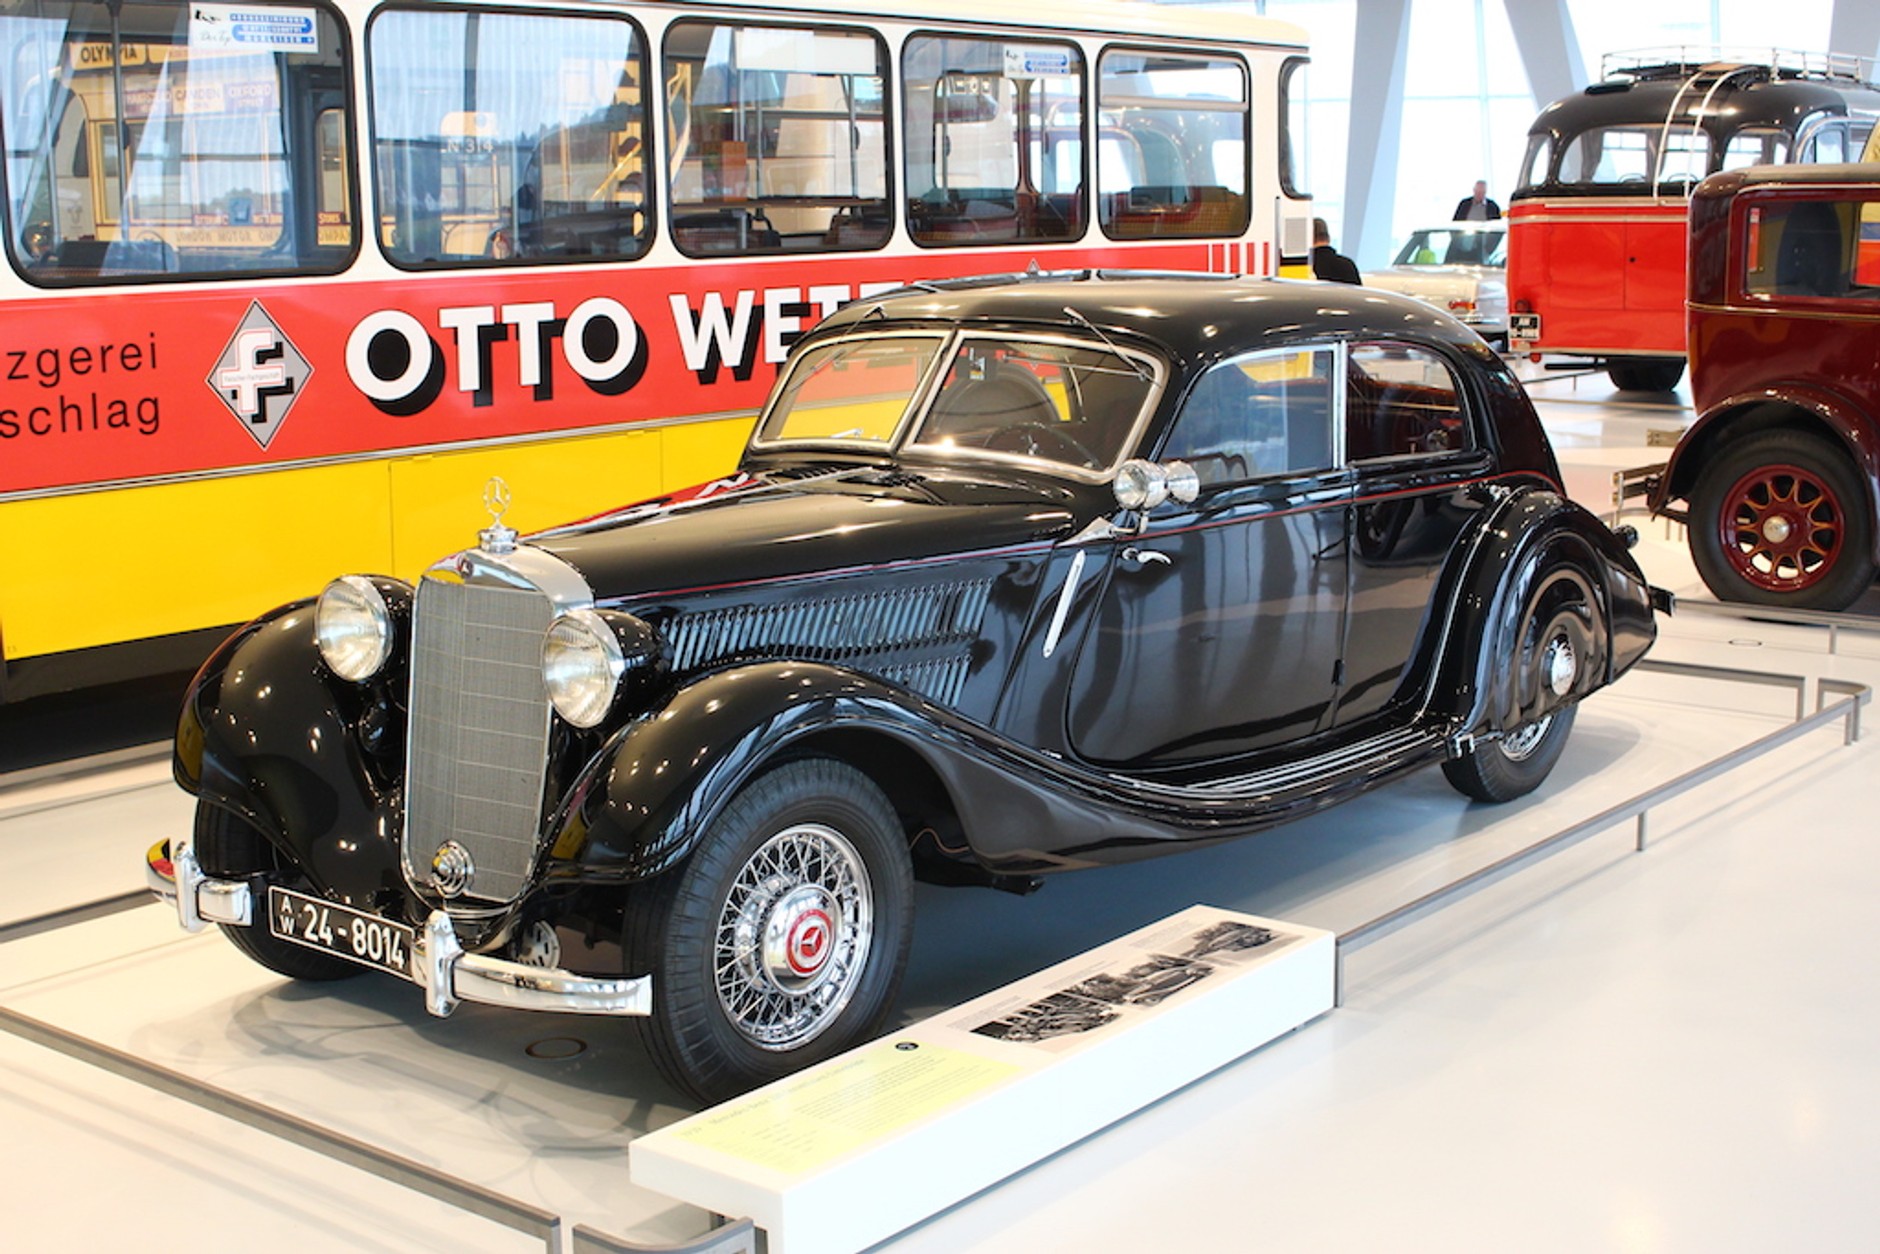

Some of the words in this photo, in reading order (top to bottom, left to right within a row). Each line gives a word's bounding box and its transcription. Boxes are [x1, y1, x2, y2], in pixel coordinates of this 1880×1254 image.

[6, 332, 157, 389] zgerei
[345, 296, 640, 402] OTTO
[668, 281, 905, 371] WET
[0, 392, 160, 439] schlag
